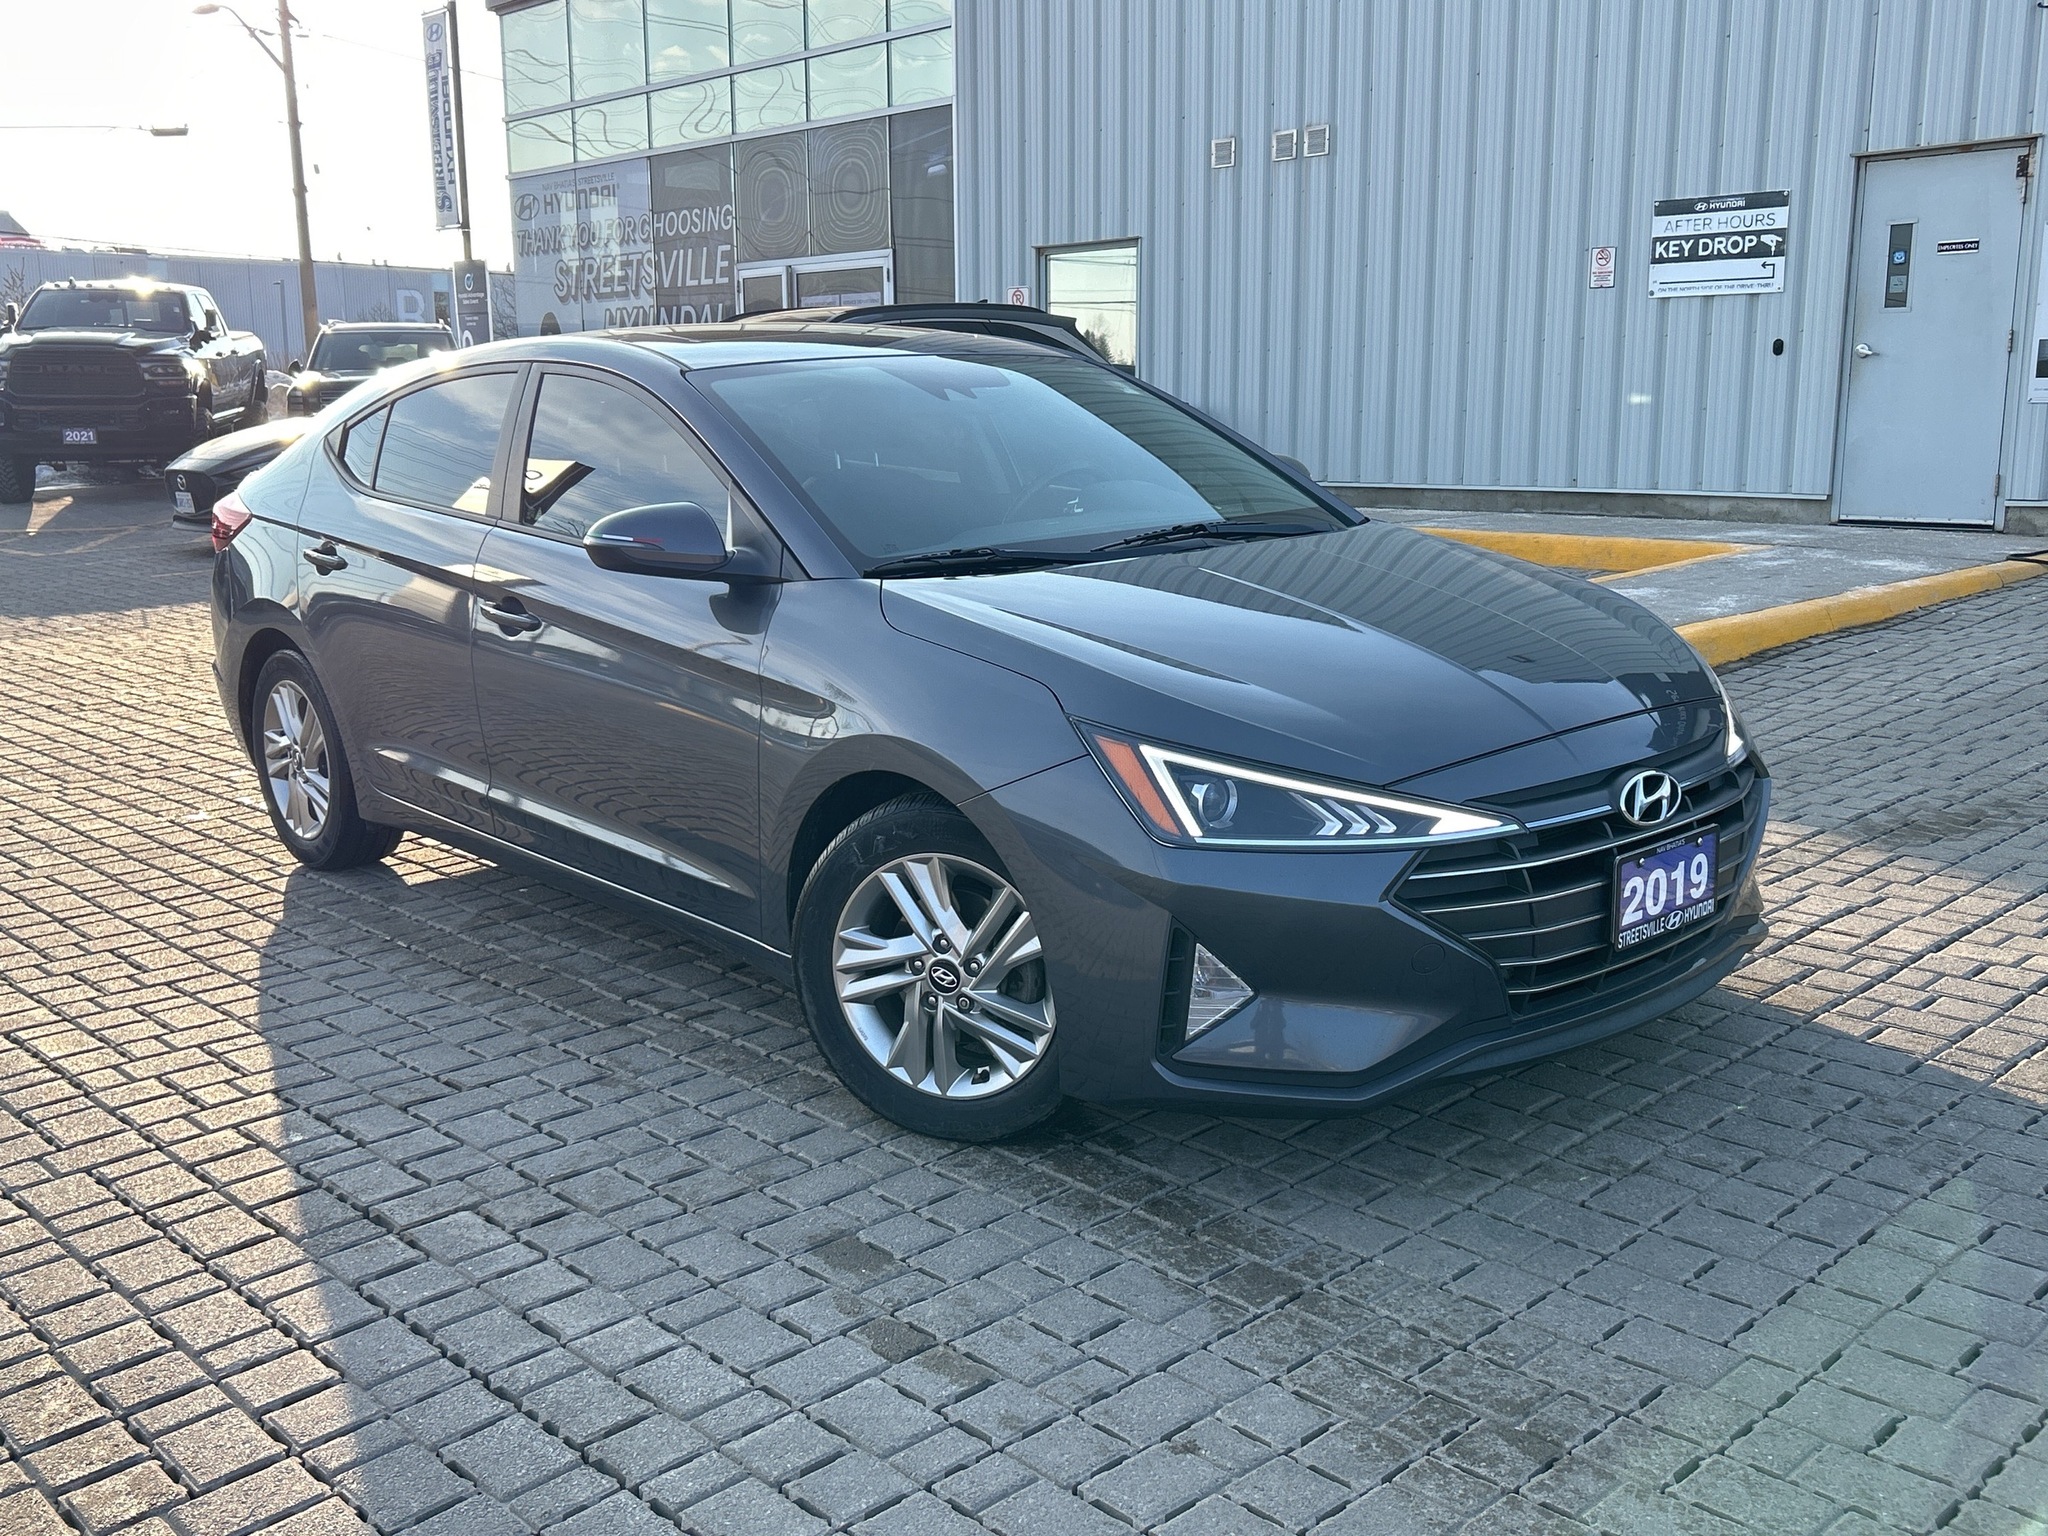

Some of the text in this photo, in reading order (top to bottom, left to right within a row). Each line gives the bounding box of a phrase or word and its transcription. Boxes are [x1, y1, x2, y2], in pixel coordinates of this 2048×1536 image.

[427, 50, 452, 212] STREETSVILLE
[441, 75, 455, 185] HYUNDAI
[544, 183, 617, 215] HYUNDAI
[577, 172, 615, 186] STREETSVILLE
[1663, 212, 1776, 233] AFTER HOURS
[1709, 200, 1746, 209] HYUNDAI
[517, 203, 734, 257] THANK YOU FOR CHOOSING
[1655, 235, 1758, 258] KEY DROP
[553, 244, 732, 303] STREETSVILLE
[65, 431, 94, 441] 2021
[1622, 853, 1708, 926] 2019
[1617, 898, 1715, 948] STREETSVILLE HYUNDAI
